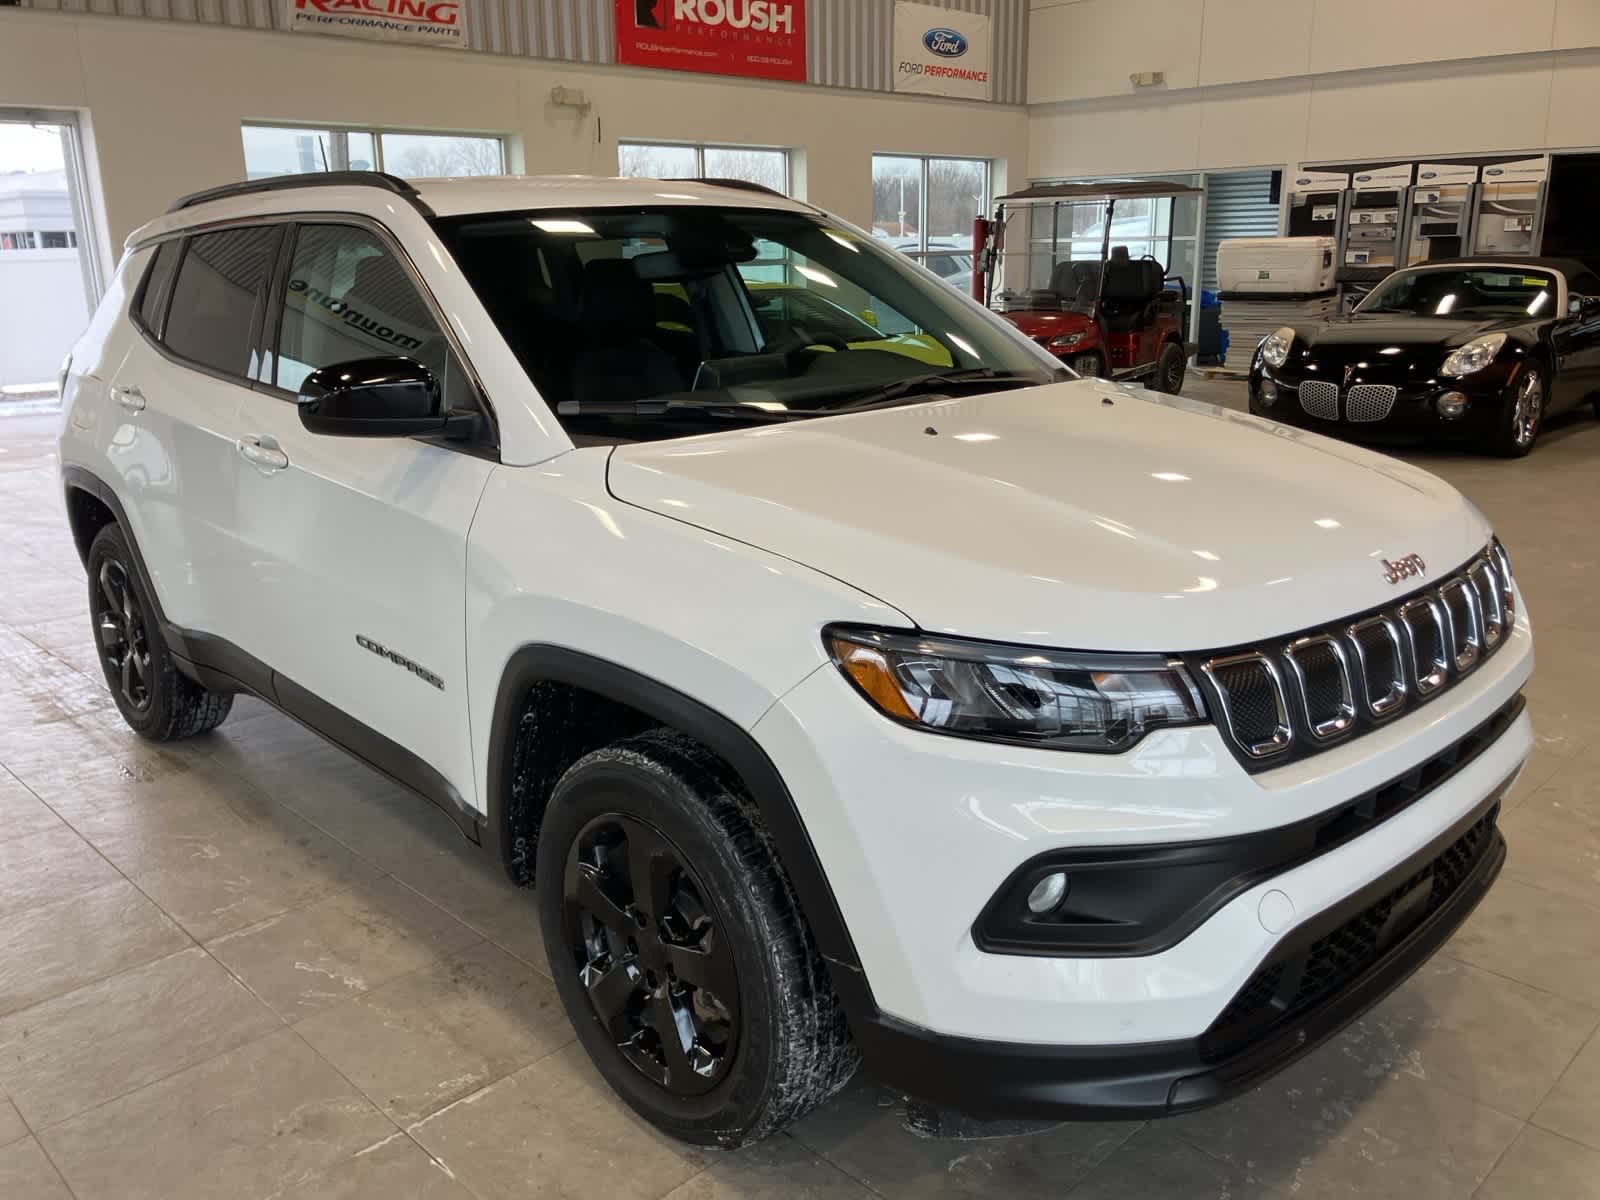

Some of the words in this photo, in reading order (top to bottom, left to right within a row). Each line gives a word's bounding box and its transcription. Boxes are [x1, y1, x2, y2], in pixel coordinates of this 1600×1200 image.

[295, 12, 417, 32] PERFORMANCE
[417, 25, 461, 37] PARTS
[673, 0, 793, 34] ROUSH
[931, 31, 961, 54] Ford
[898, 61, 924, 75] FORD
[923, 64, 989, 82] PERFORMANCE
[1381, 553, 1426, 585] Jeep
[355, 633, 446, 691] COMPASS
